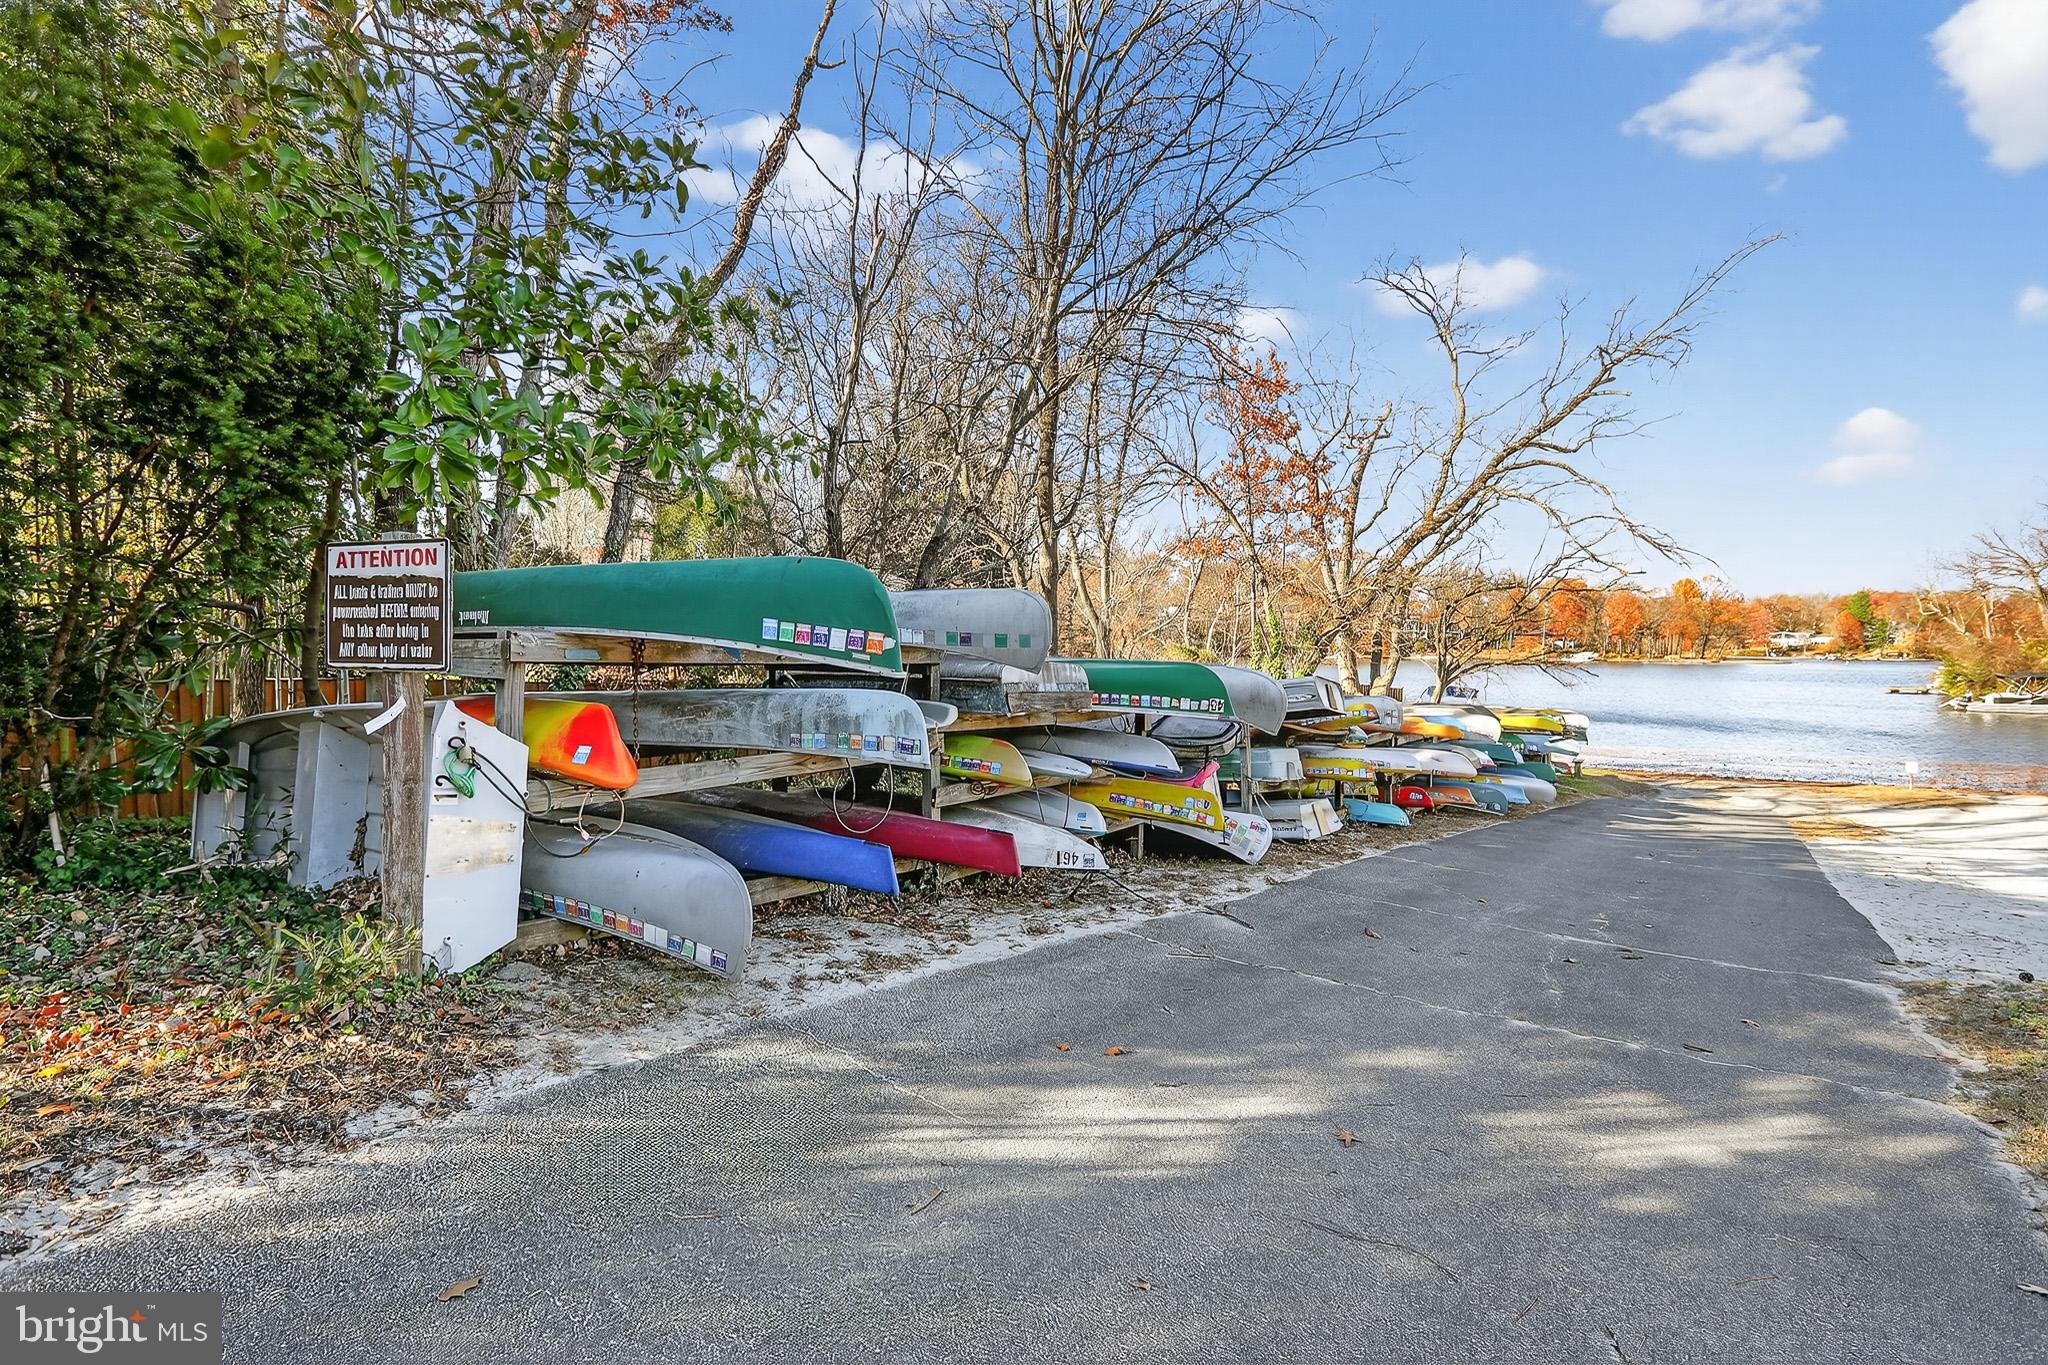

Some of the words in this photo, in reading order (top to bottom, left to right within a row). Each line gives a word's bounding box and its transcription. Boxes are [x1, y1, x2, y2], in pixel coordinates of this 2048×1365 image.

[336, 547, 438, 569] ATTENTION
[334, 585, 348, 599] ALL
[342, 623, 355, 638] the
[339, 642, 355, 657] ANY
[379, 643, 398, 660] body
